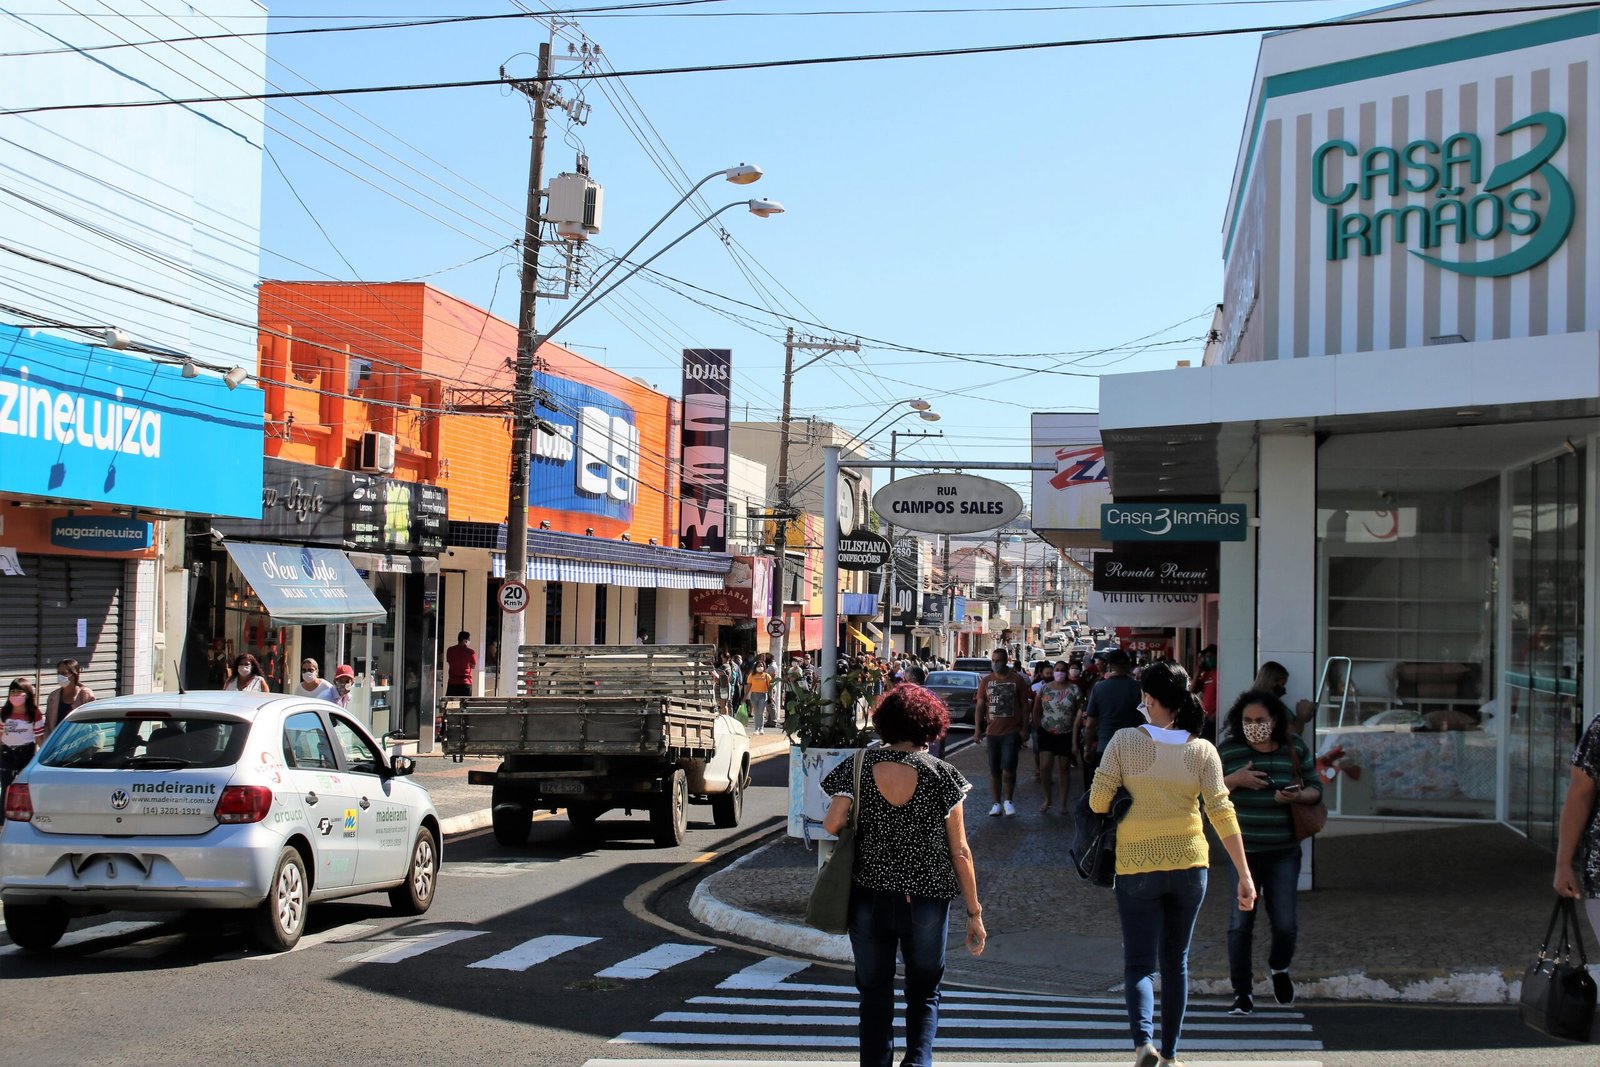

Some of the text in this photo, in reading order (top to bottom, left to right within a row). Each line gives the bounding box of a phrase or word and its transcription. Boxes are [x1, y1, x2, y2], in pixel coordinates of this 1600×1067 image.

[1312, 132, 1481, 205] CASA
[685, 364, 727, 380] LOJAS
[532, 420, 574, 461] LOJAS
[937, 486, 957, 496] RUA
[285, 478, 324, 521] Style
[892, 501, 1004, 515] CAMPOS SALES
[1107, 509, 1152, 525] CASA
[838, 540, 888, 553] ULISTANA
[263, 552, 338, 588] New Style
[1105, 561, 1209, 579] Renata Reami
[504, 586, 523, 599] 20
[694, 588, 749, 605] PASTELARIA
[132, 780, 215, 794] madeiranit
[143, 807, 202, 815] (14) 3201-1919
[274, 810, 303, 823] arauco
[376, 806, 408, 823] madeiranit
